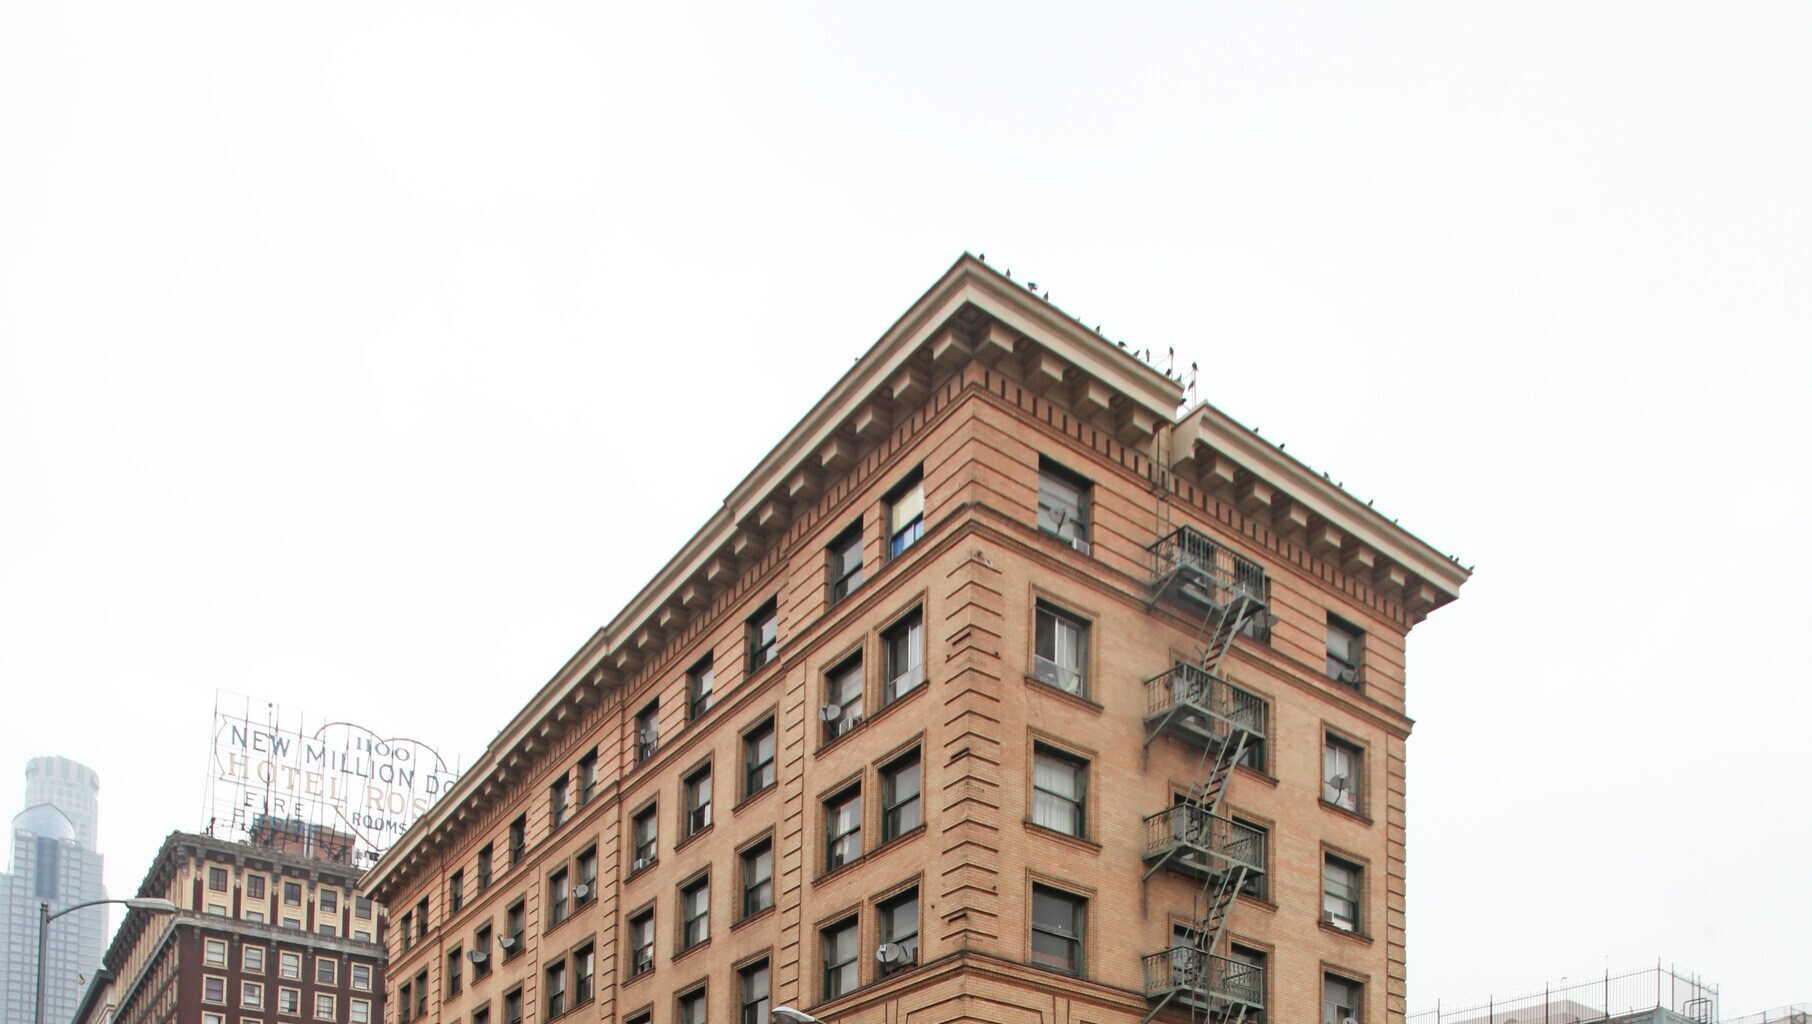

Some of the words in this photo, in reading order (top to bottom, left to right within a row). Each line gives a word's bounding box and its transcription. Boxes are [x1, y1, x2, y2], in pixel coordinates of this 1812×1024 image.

[232, 724, 290, 757] NEW
[306, 744, 415, 789] MILLION
[228, 752, 347, 802] HOTEL
[244, 791, 304, 818] FIRE
[352, 812, 407, 835] ROOMS
